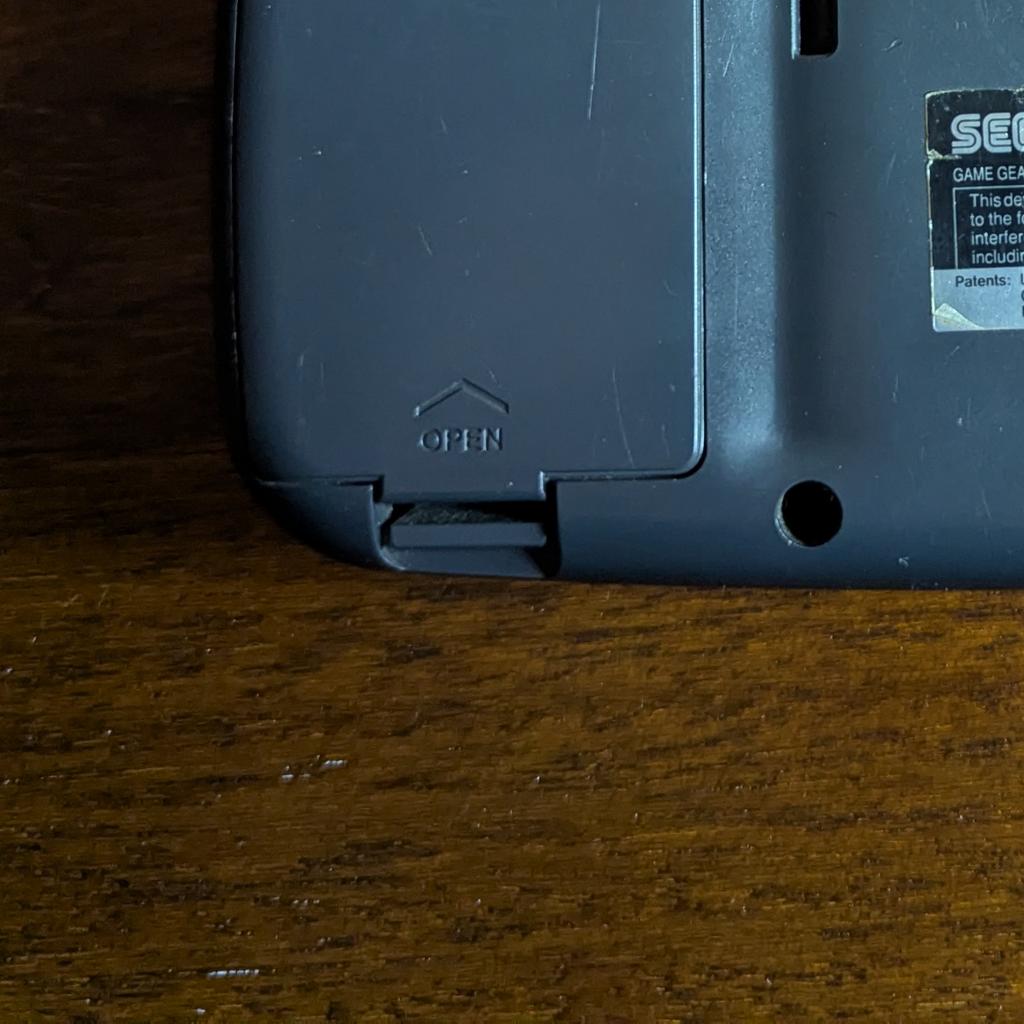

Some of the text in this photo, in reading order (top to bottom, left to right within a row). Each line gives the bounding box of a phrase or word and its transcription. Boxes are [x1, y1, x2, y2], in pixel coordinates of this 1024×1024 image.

[953, 166, 993, 181] GAME
[970, 193, 1001, 207] This
[970, 212, 984, 226] to
[989, 211, 1012, 225] the
[955, 276, 1011, 287] Patents:
[419, 428, 503, 452] OPEN
